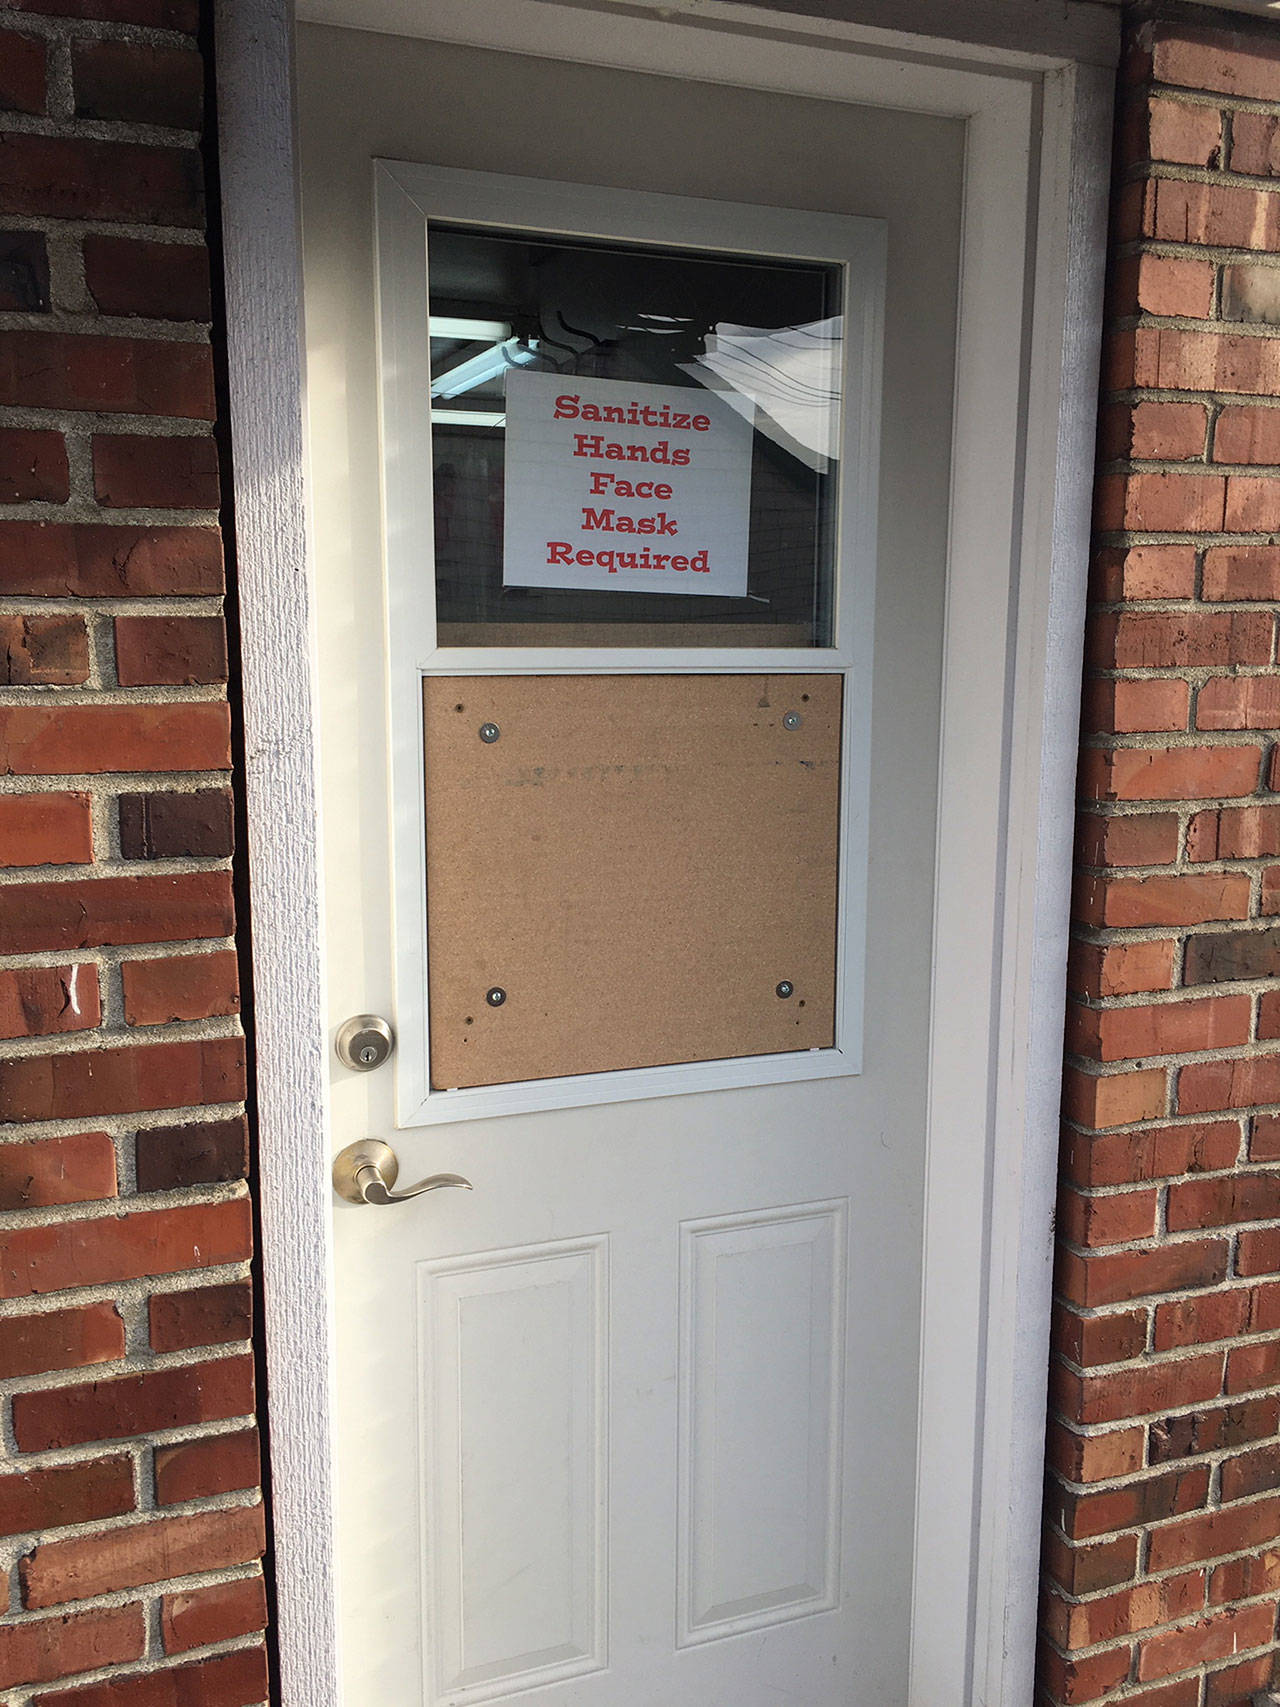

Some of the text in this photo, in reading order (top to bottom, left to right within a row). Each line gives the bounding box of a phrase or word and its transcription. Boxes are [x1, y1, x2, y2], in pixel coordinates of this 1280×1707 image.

[554, 394, 711, 431] Sanitize
[573, 434, 691, 466] Hands
[589, 472, 673, 500] Face
[581, 508, 678, 536] Mask
[546, 541, 711, 573] Required
